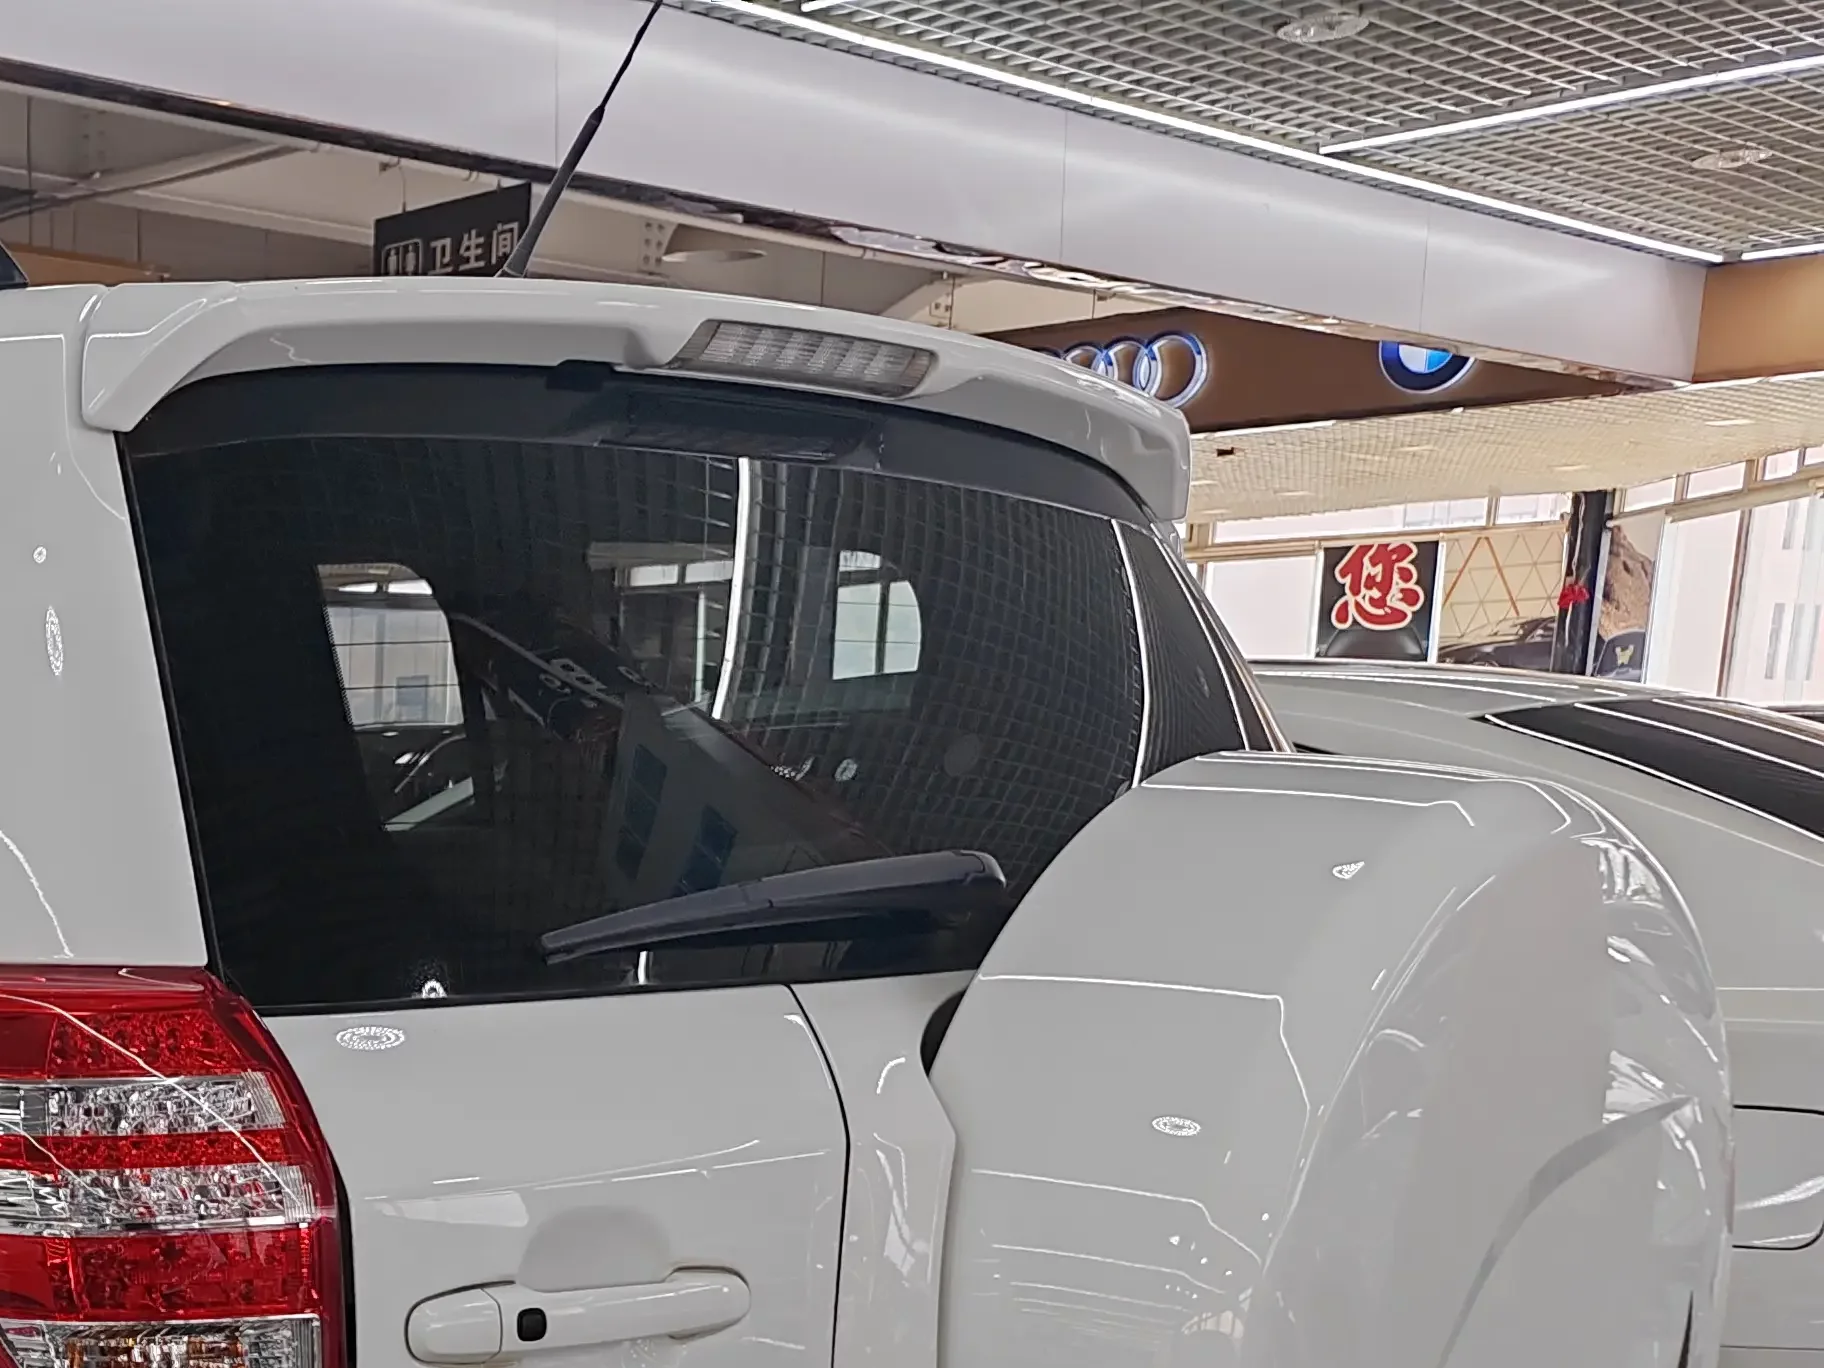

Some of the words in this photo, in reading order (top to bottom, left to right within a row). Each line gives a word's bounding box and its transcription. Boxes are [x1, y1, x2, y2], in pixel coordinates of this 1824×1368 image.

[427, 221, 520, 276] 卫生间
[1331, 541, 1424, 630] 您
